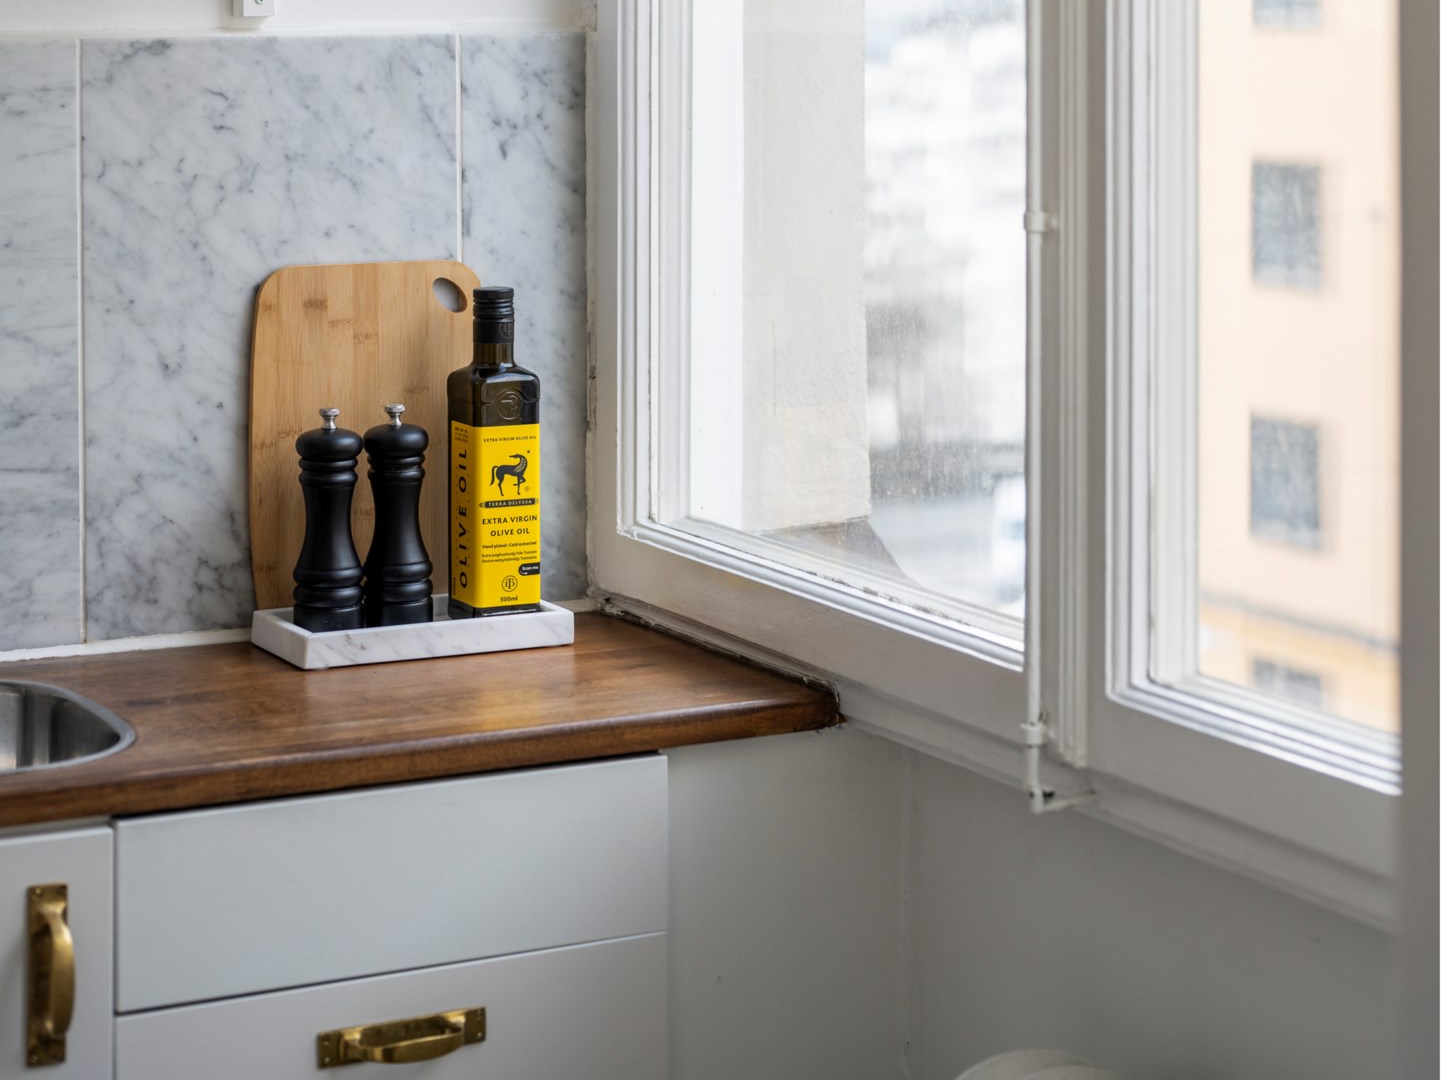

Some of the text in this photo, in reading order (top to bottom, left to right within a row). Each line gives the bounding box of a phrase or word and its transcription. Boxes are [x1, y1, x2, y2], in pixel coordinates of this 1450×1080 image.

[459, 449, 467, 493] OIL
[482, 515, 538, 525] EXTRA VIRGIN
[490, 527, 530, 537] OLIVE OIL
[459, 506, 467, 588] OLIVE
